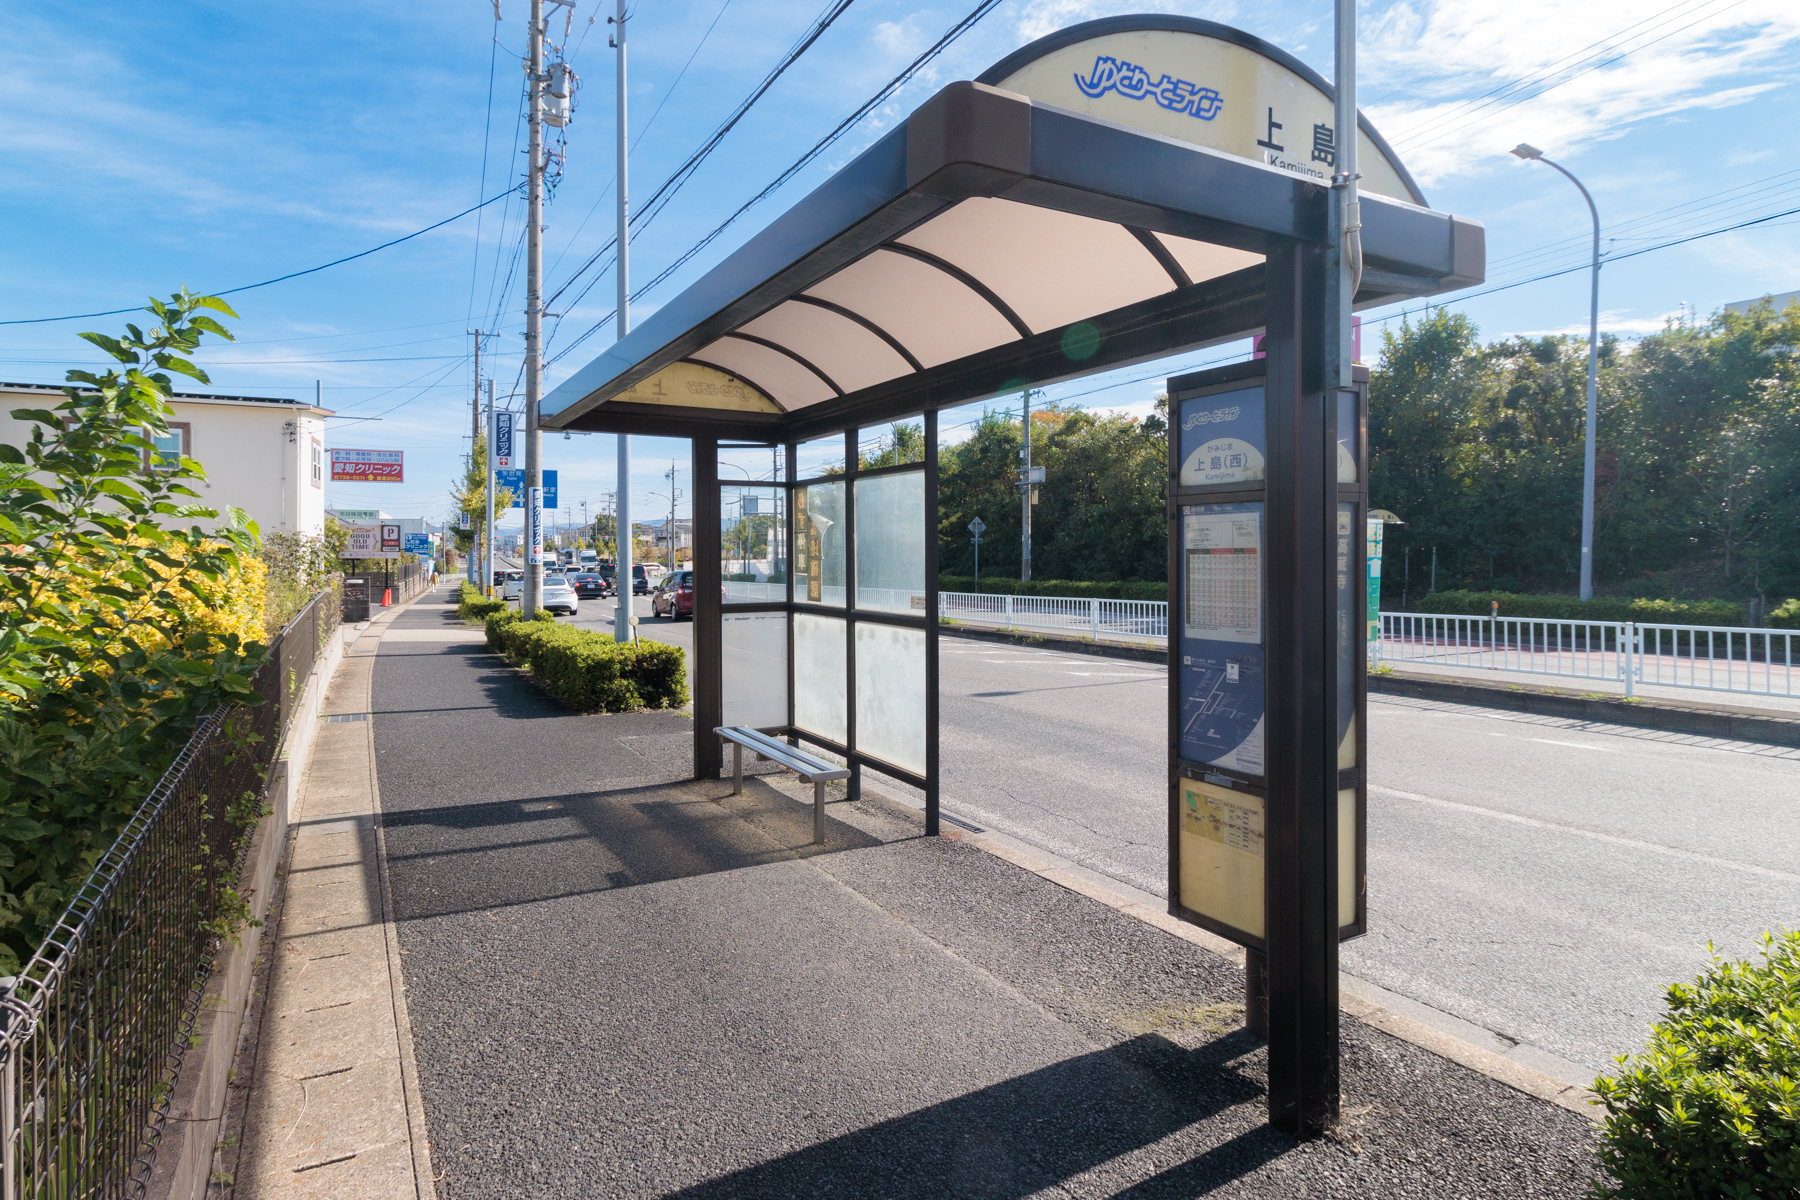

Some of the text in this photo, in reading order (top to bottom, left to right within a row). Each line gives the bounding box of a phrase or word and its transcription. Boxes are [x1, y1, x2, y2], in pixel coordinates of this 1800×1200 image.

[1073, 55, 1224, 121] ゆとりーとライン
[1256, 106, 1335, 168] 上島
[1270, 154, 1324, 179] Kamijima
[1182, 406, 1241, 430] ゆとりーとライン
[498, 414, 510, 456] 愛知クリニック
[1207, 443, 1233, 453] かみじま
[333, 463, 401, 475] 愛知クリニック
[1205, 472, 1235, 480] Kamijima
[533, 490, 541, 545] 愛知クリニック
[387, 527, 395, 538] P
